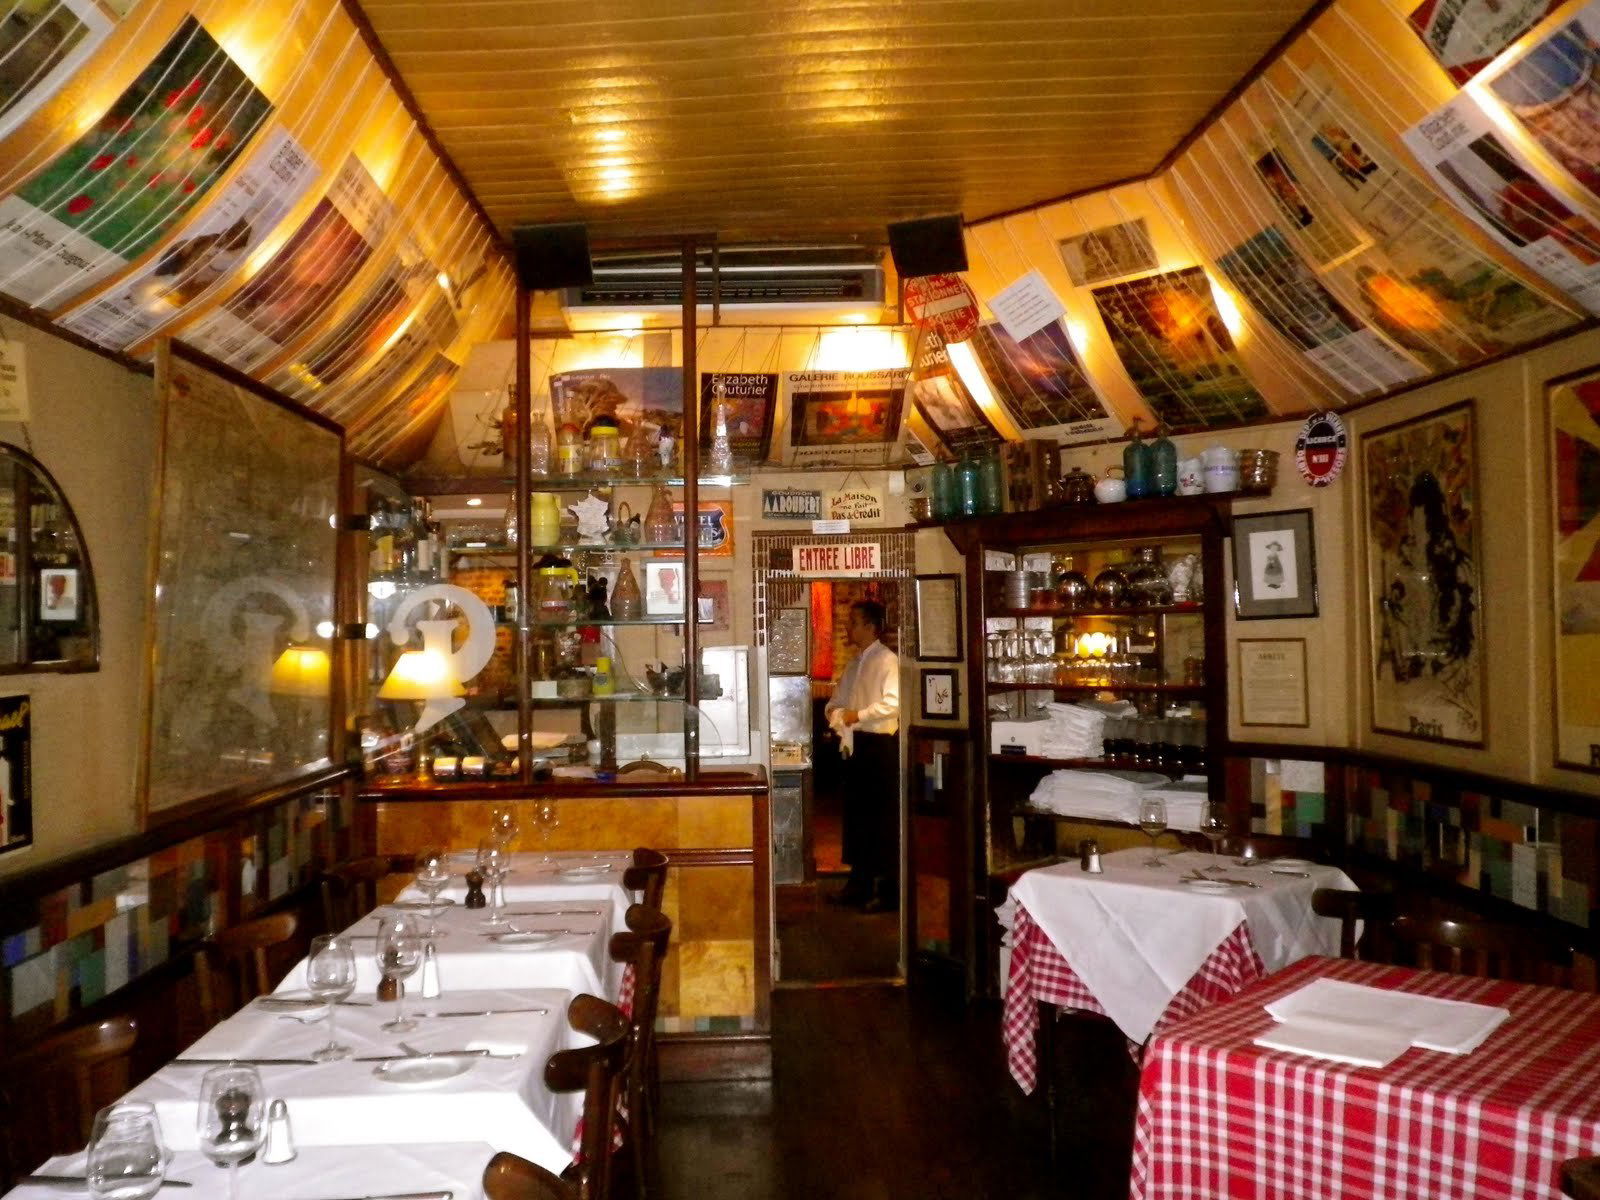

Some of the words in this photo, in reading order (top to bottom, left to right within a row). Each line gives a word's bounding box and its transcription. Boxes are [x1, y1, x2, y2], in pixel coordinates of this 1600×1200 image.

[789, 372, 839, 382] GALERIE
[831, 496, 842, 507] La
[844, 491, 878, 503] Maison
[674, 515, 714, 526] VIEL
[832, 510, 846, 520] Pas
[799, 547, 840, 571] ENTREE
[844, 546, 875, 569] LIBRE
